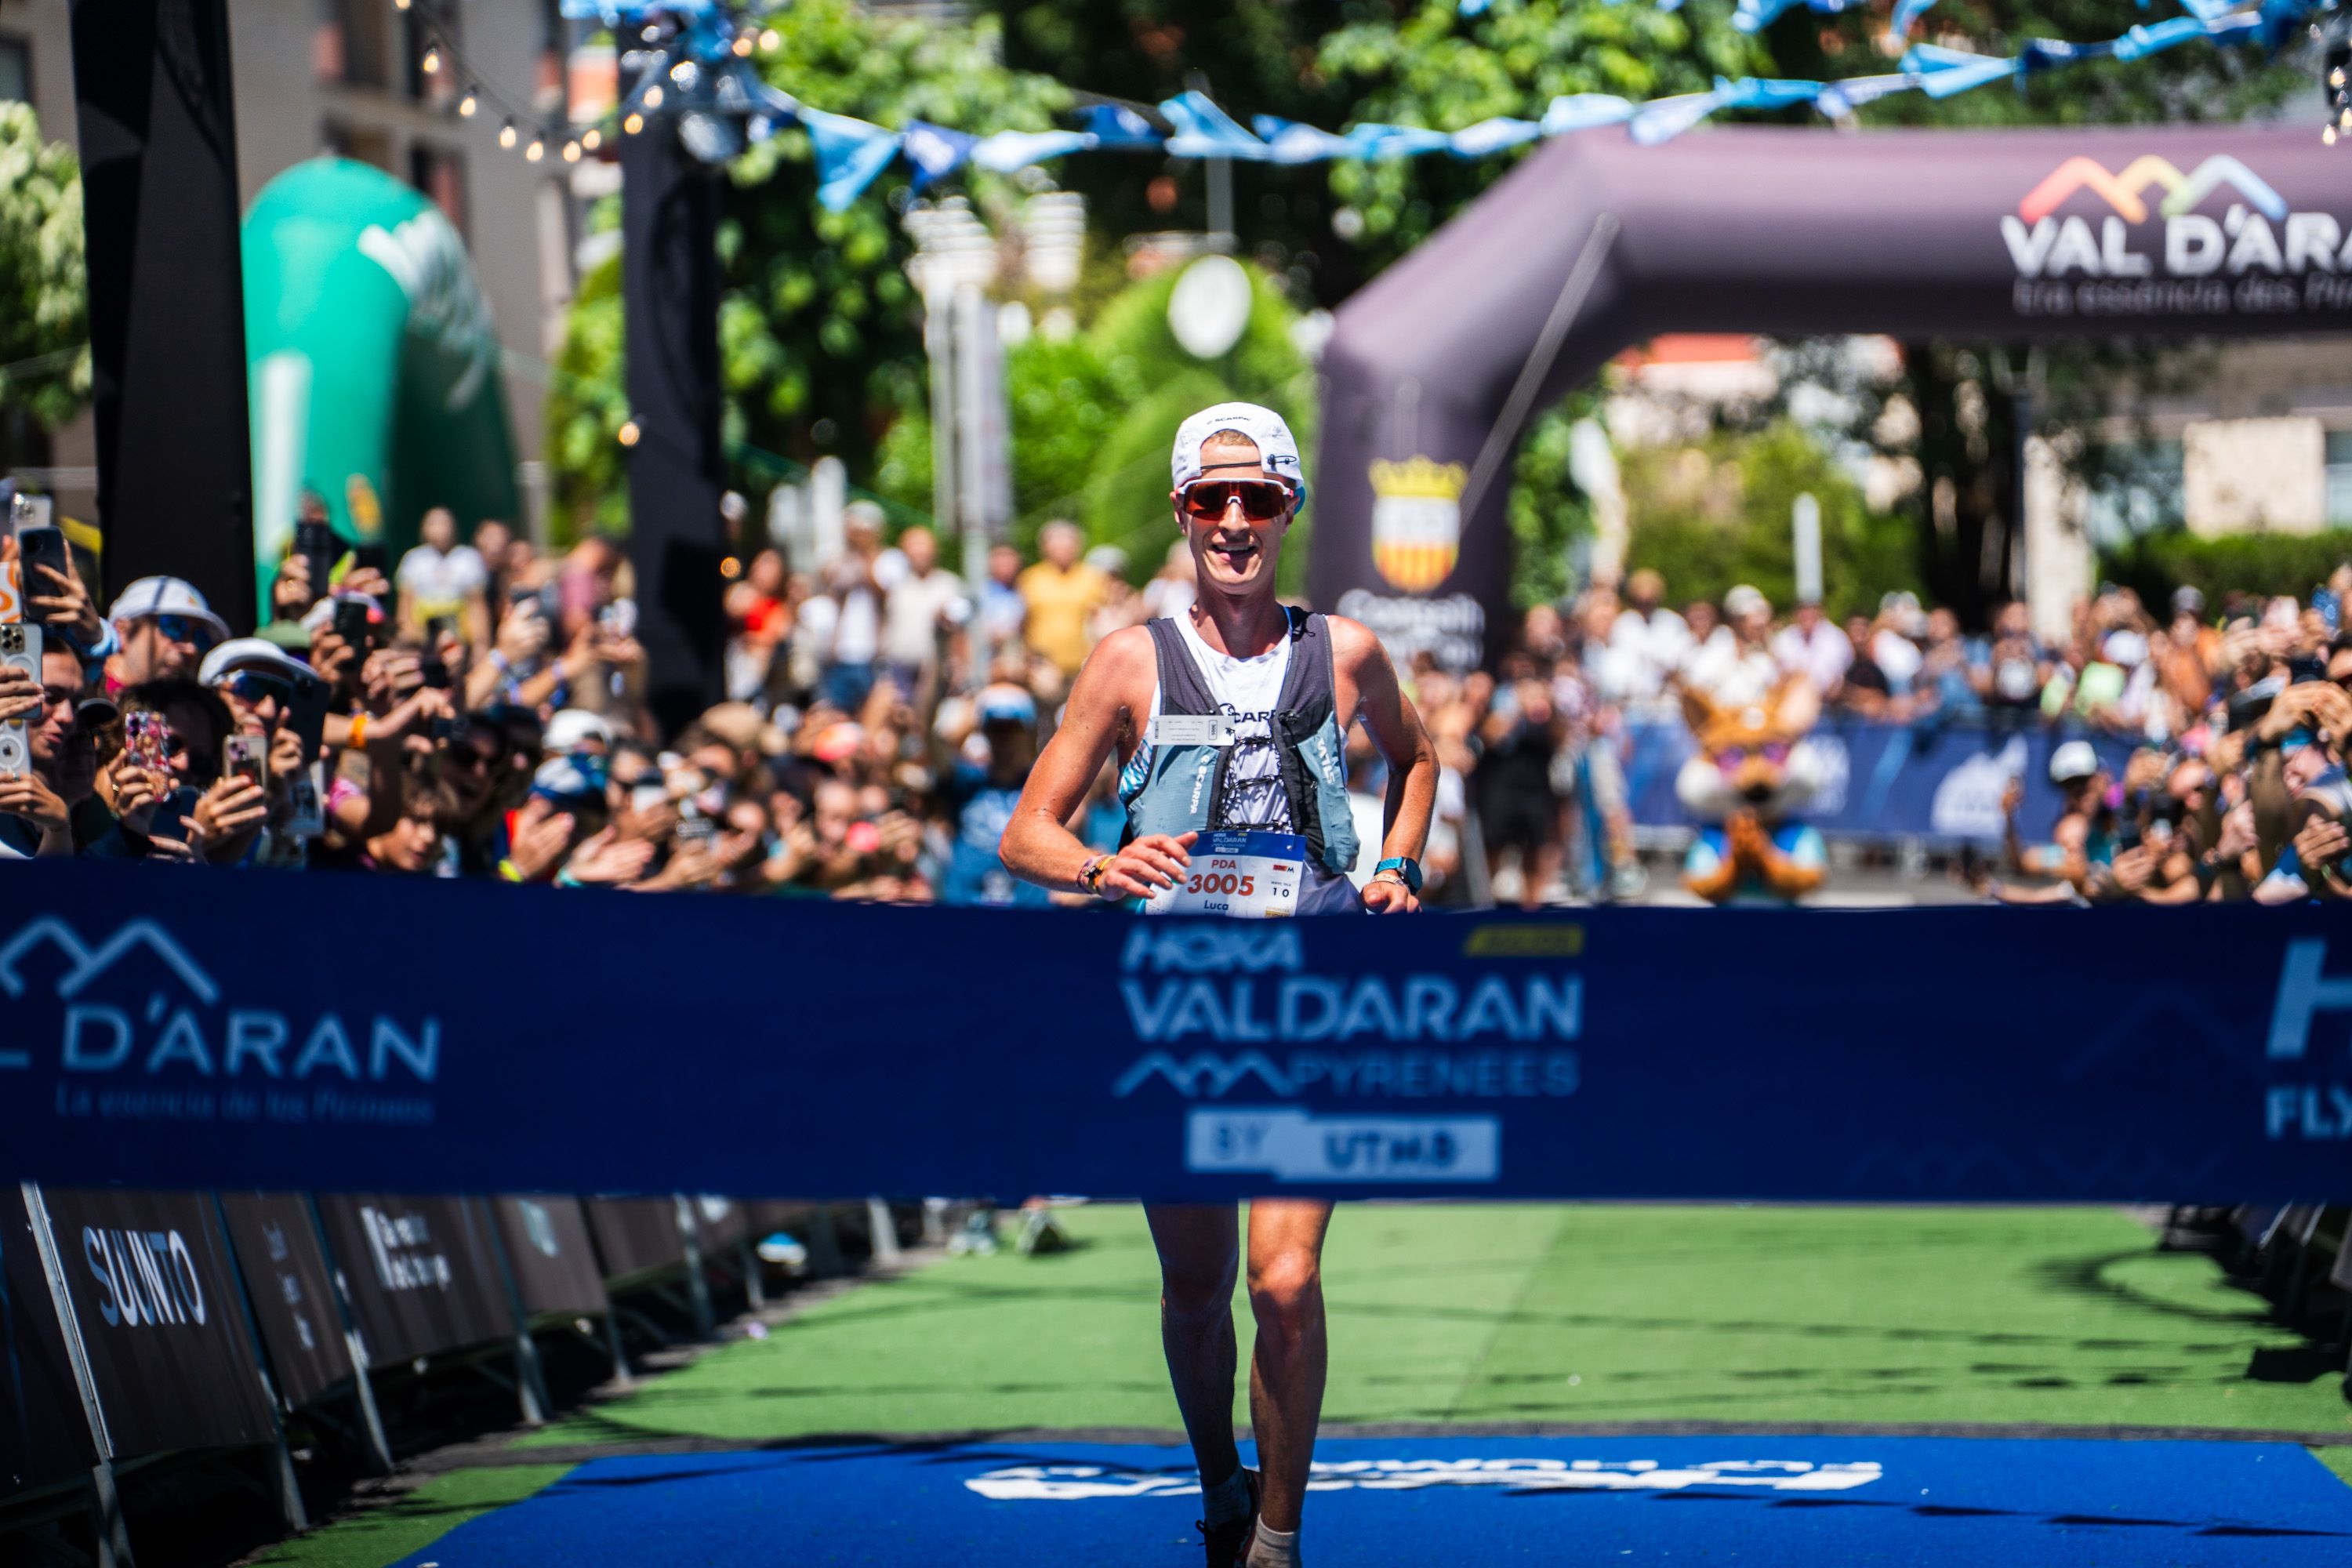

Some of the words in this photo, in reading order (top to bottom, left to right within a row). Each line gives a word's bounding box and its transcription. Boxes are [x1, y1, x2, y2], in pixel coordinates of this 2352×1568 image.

[2001, 215, 2152, 277] VAL
[2165, 203, 2352, 277] D'AR
[1190, 765, 1207, 815] SCARPA
[1187, 873, 1254, 896] 3005
[1211, 859, 1236, 869] PDA
[1203, 899, 1229, 910] Luca
[1123, 926, 1301, 971] HOKA
[63, 993, 441, 1080] D'ARAN
[1291, 1051, 1580, 1096] PYRENEES
[1215, 1127, 1269, 1157] BY
[1325, 1133, 1455, 1168] UTMB
[82, 1225, 206, 1327] SUUNTO
